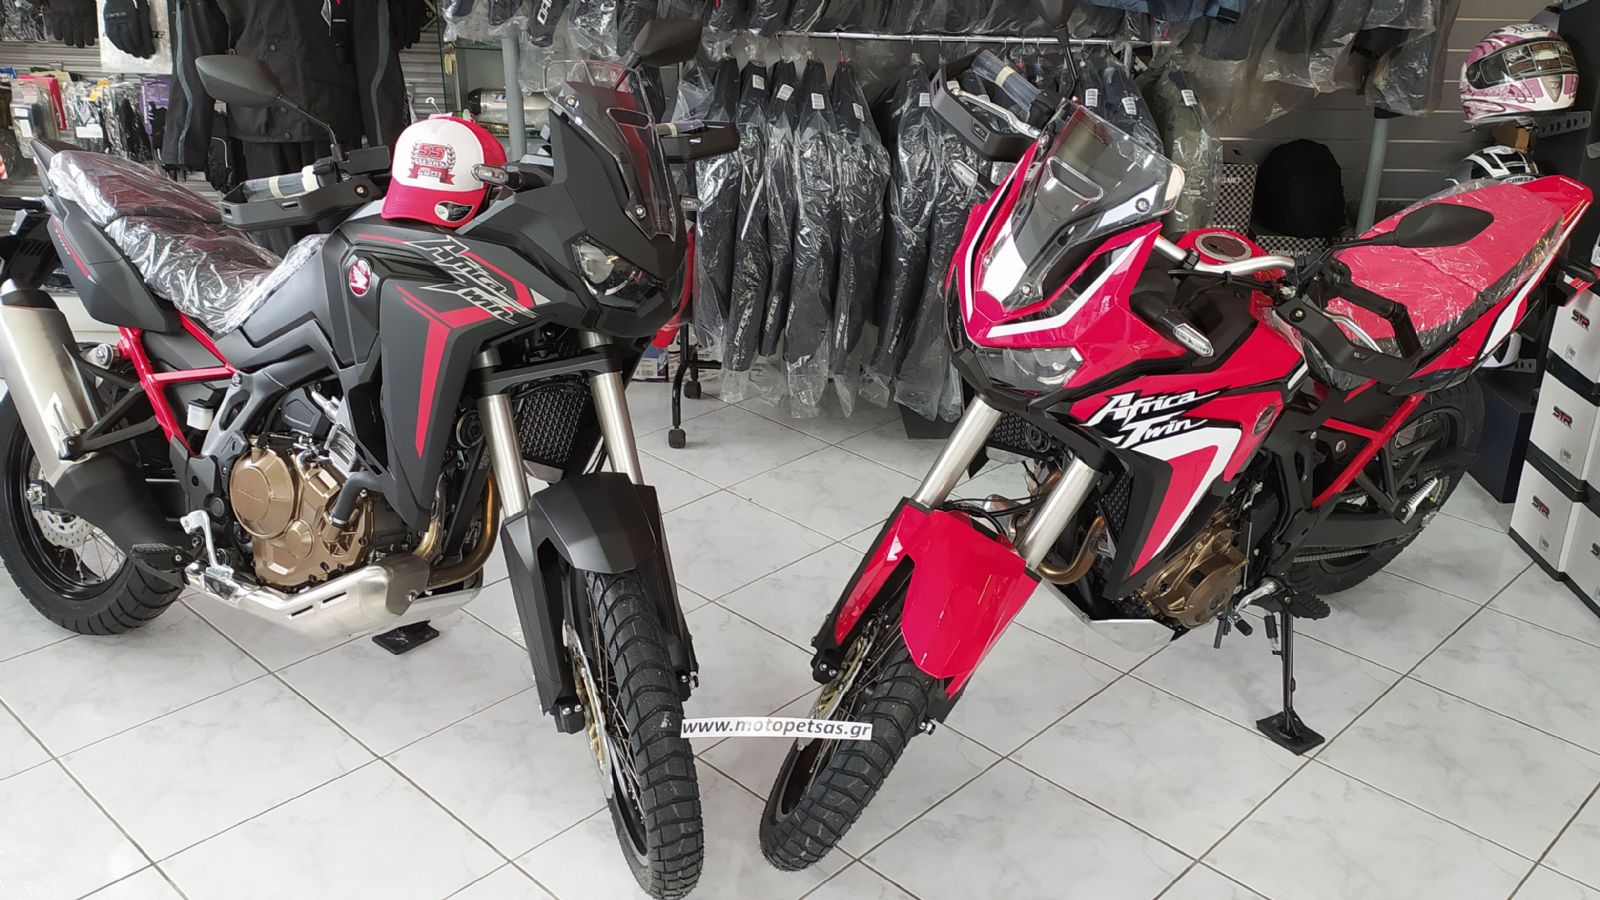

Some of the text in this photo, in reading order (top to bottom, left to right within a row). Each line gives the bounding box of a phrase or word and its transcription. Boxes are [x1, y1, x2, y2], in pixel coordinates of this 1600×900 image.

[733, 301, 754, 347] DAINESE
[1078, 390, 1221, 427] Africa
[1101, 410, 1209, 449] Twin
